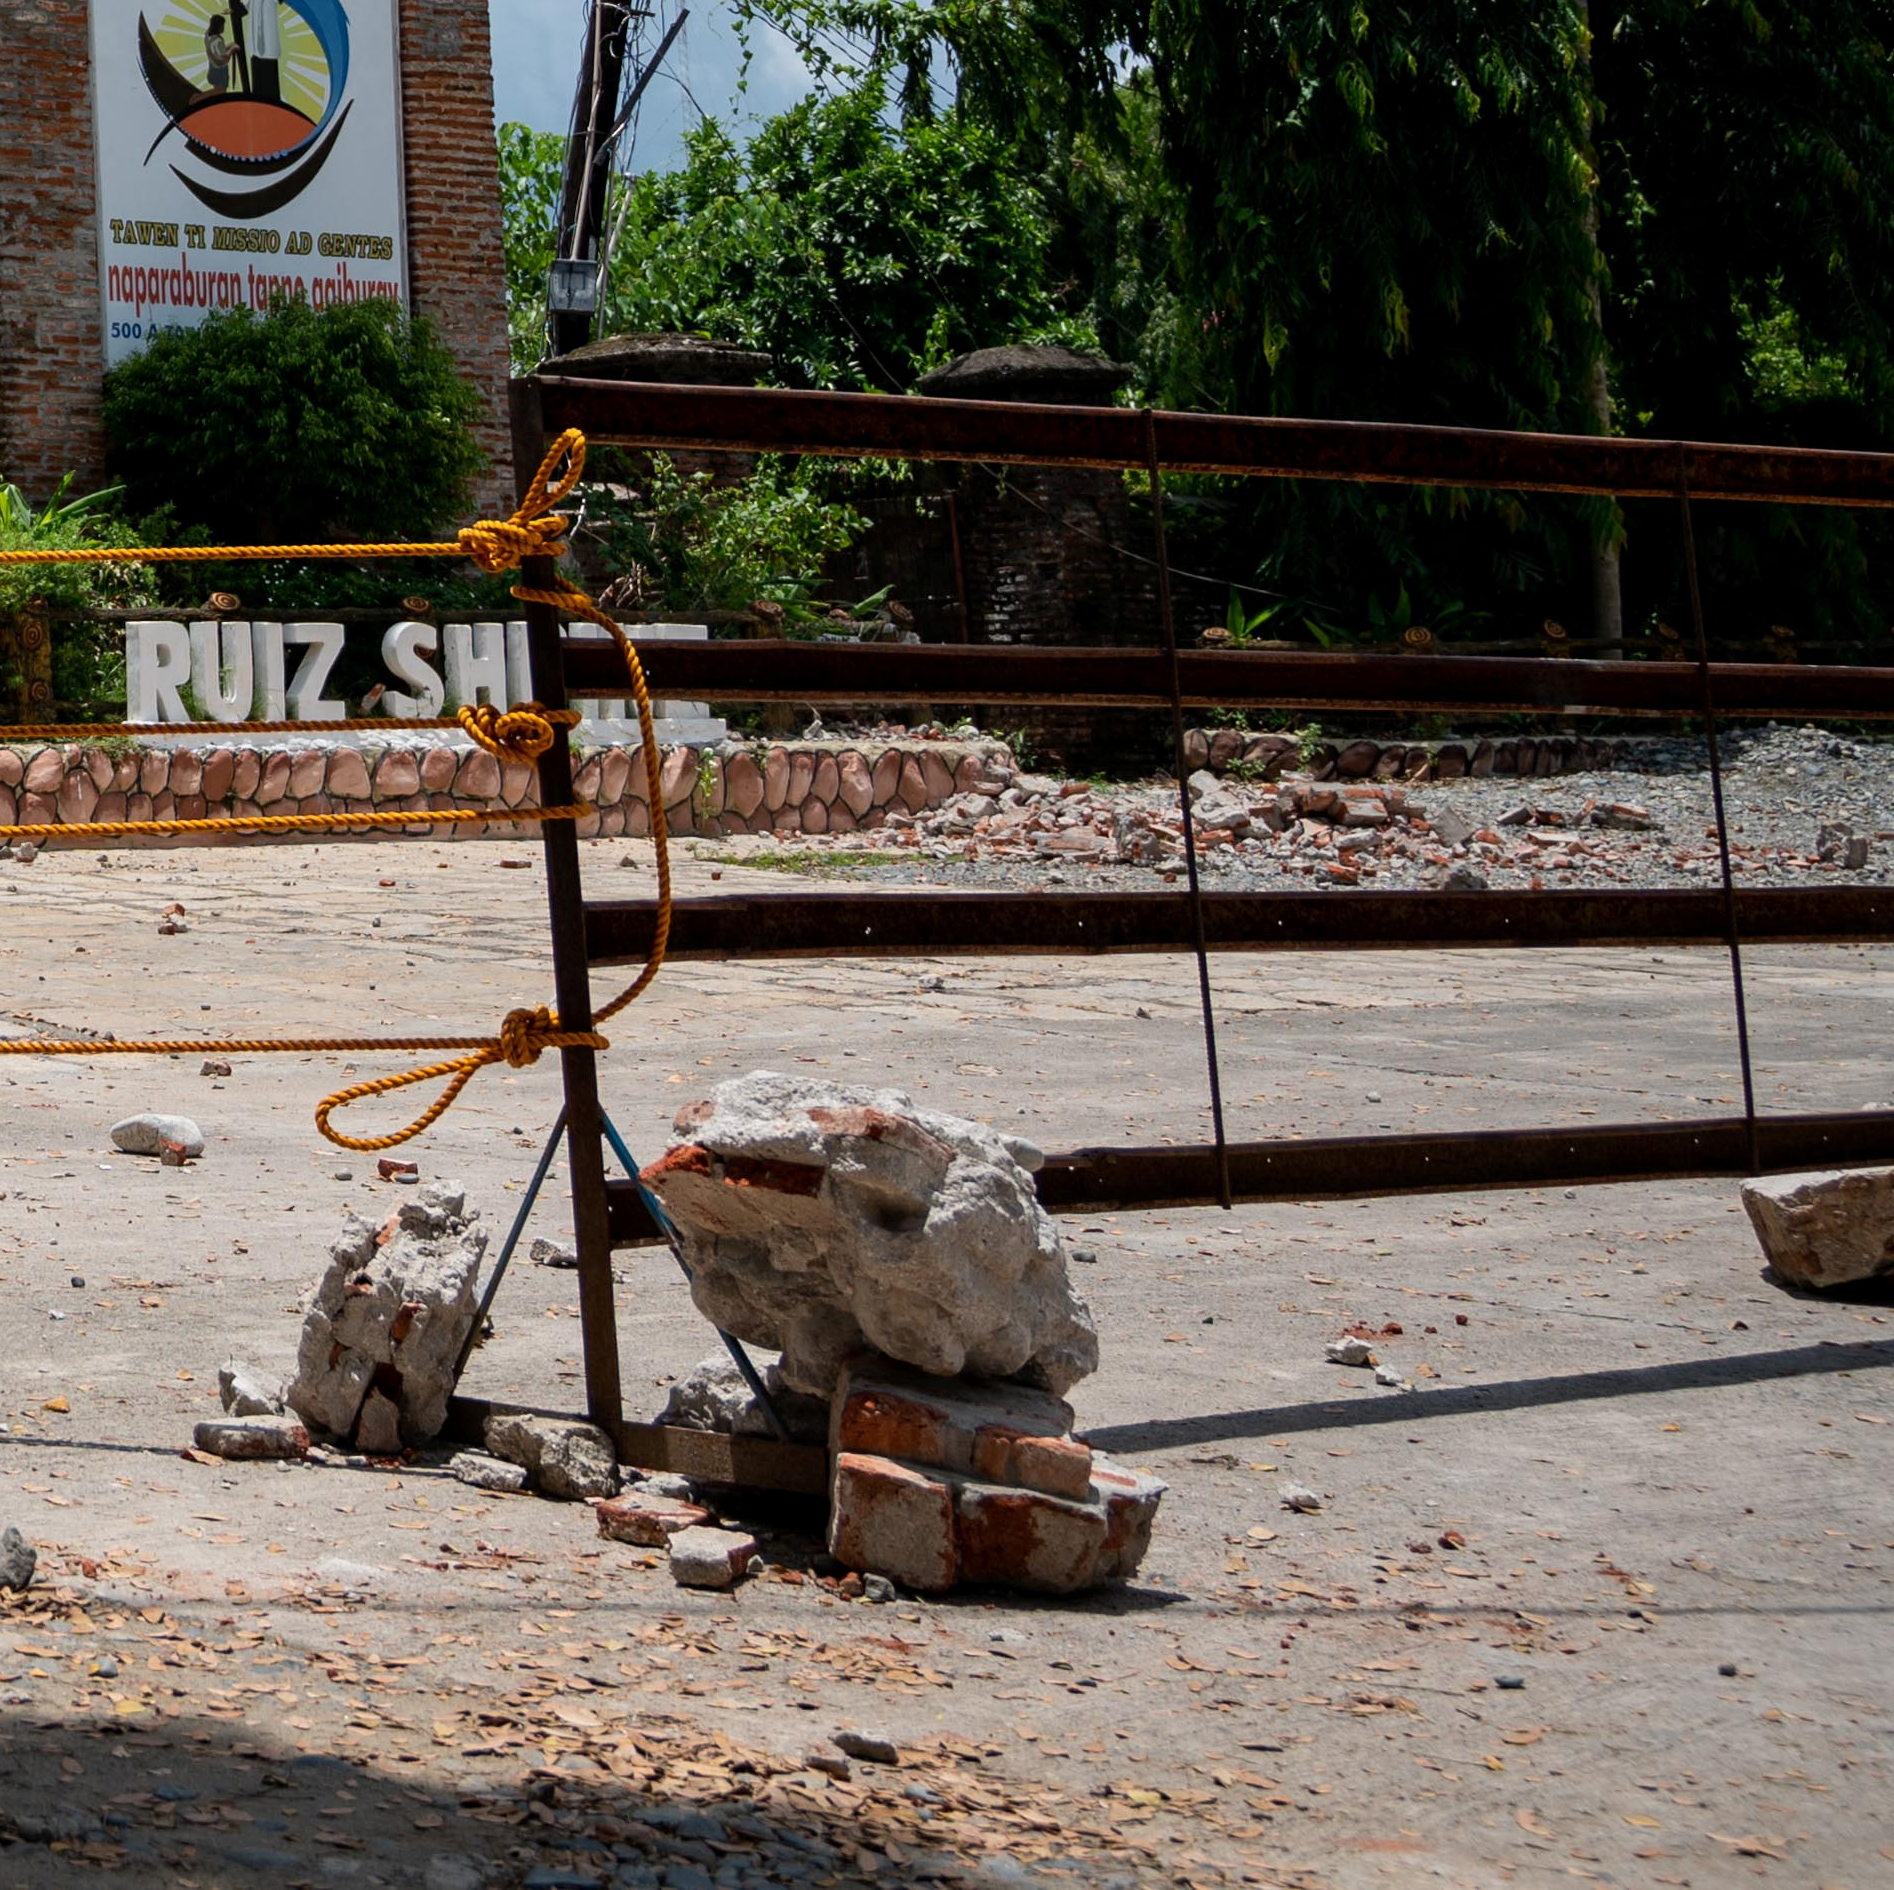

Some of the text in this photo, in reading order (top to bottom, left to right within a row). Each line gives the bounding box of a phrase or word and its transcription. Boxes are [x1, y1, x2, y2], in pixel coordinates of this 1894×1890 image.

[109, 218, 394, 261] TAWEN TI MISSIO AD GENTES
[108, 251, 243, 319] naparaburan
[111, 322, 143, 340] 500
[124, 620, 347, 723] RUIZ
